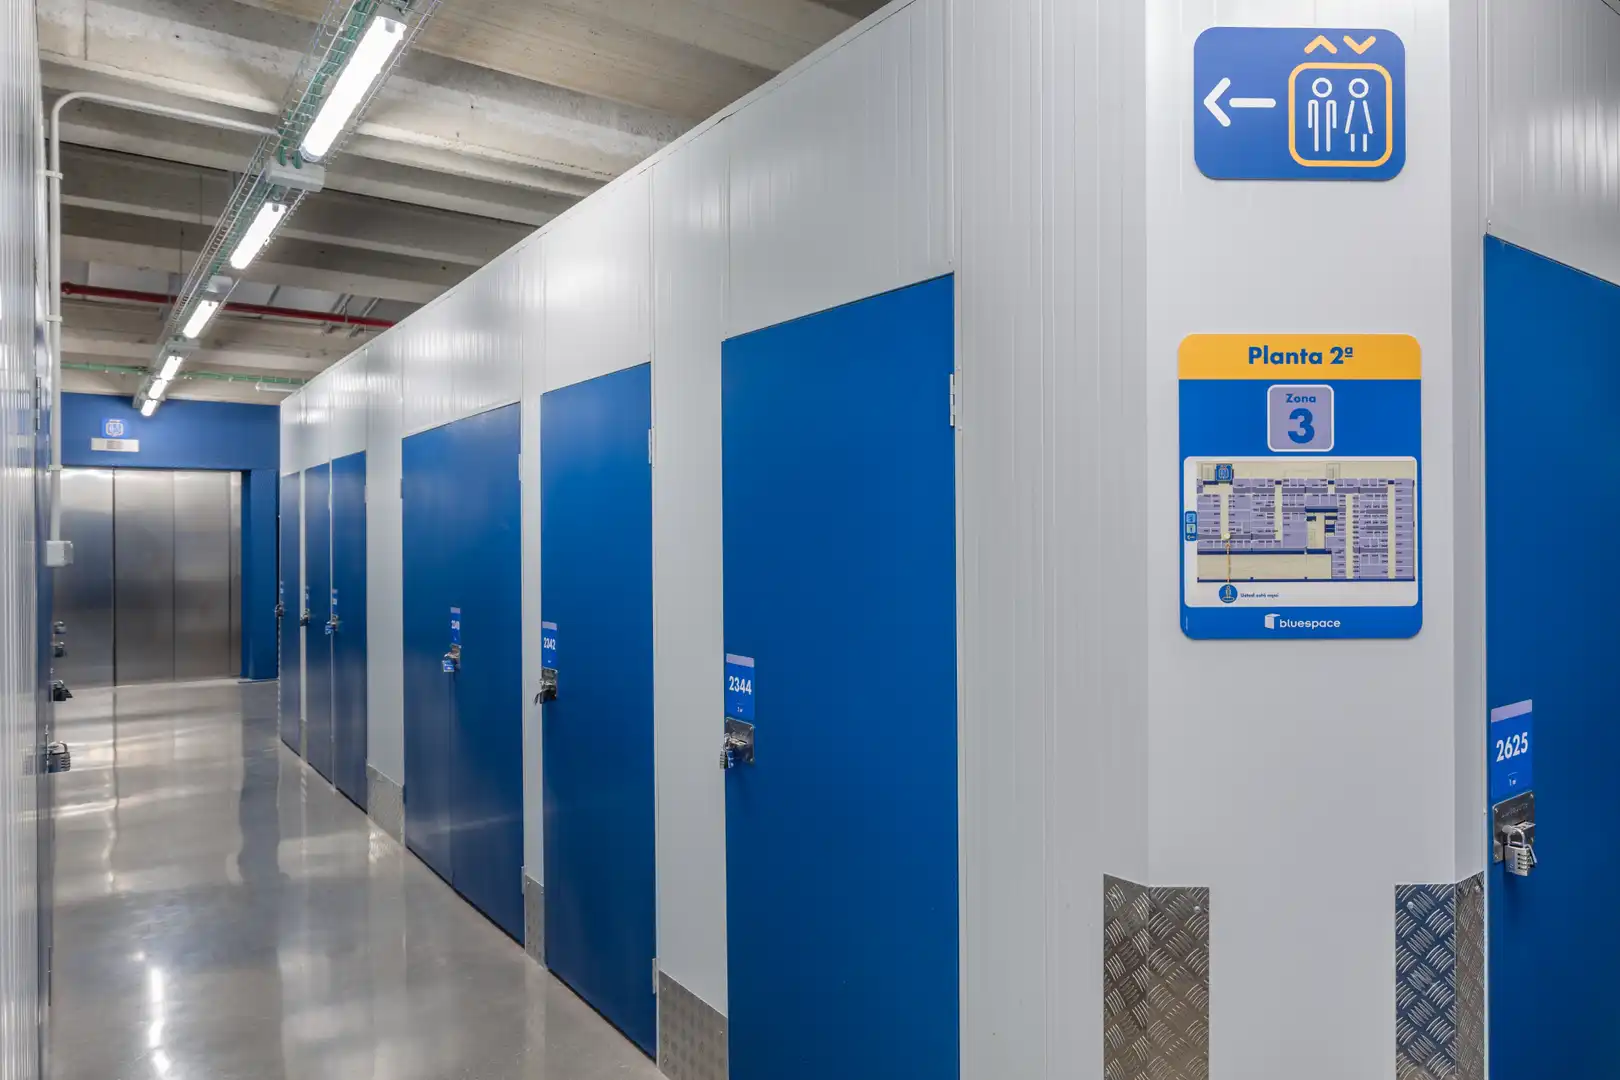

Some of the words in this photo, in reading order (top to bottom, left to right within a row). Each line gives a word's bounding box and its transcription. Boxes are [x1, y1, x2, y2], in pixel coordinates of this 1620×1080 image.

[1248, 345, 1323, 365] Planta
[1329, 346, 1354, 365] 2ª
[1285, 393, 1317, 404] Zona
[1287, 407, 1315, 444] 3
[1279, 618, 1341, 630] bluespace
[543, 637, 556, 650] 2342
[728, 675, 752, 696] 2344
[1496, 732, 1528, 762] 2625
